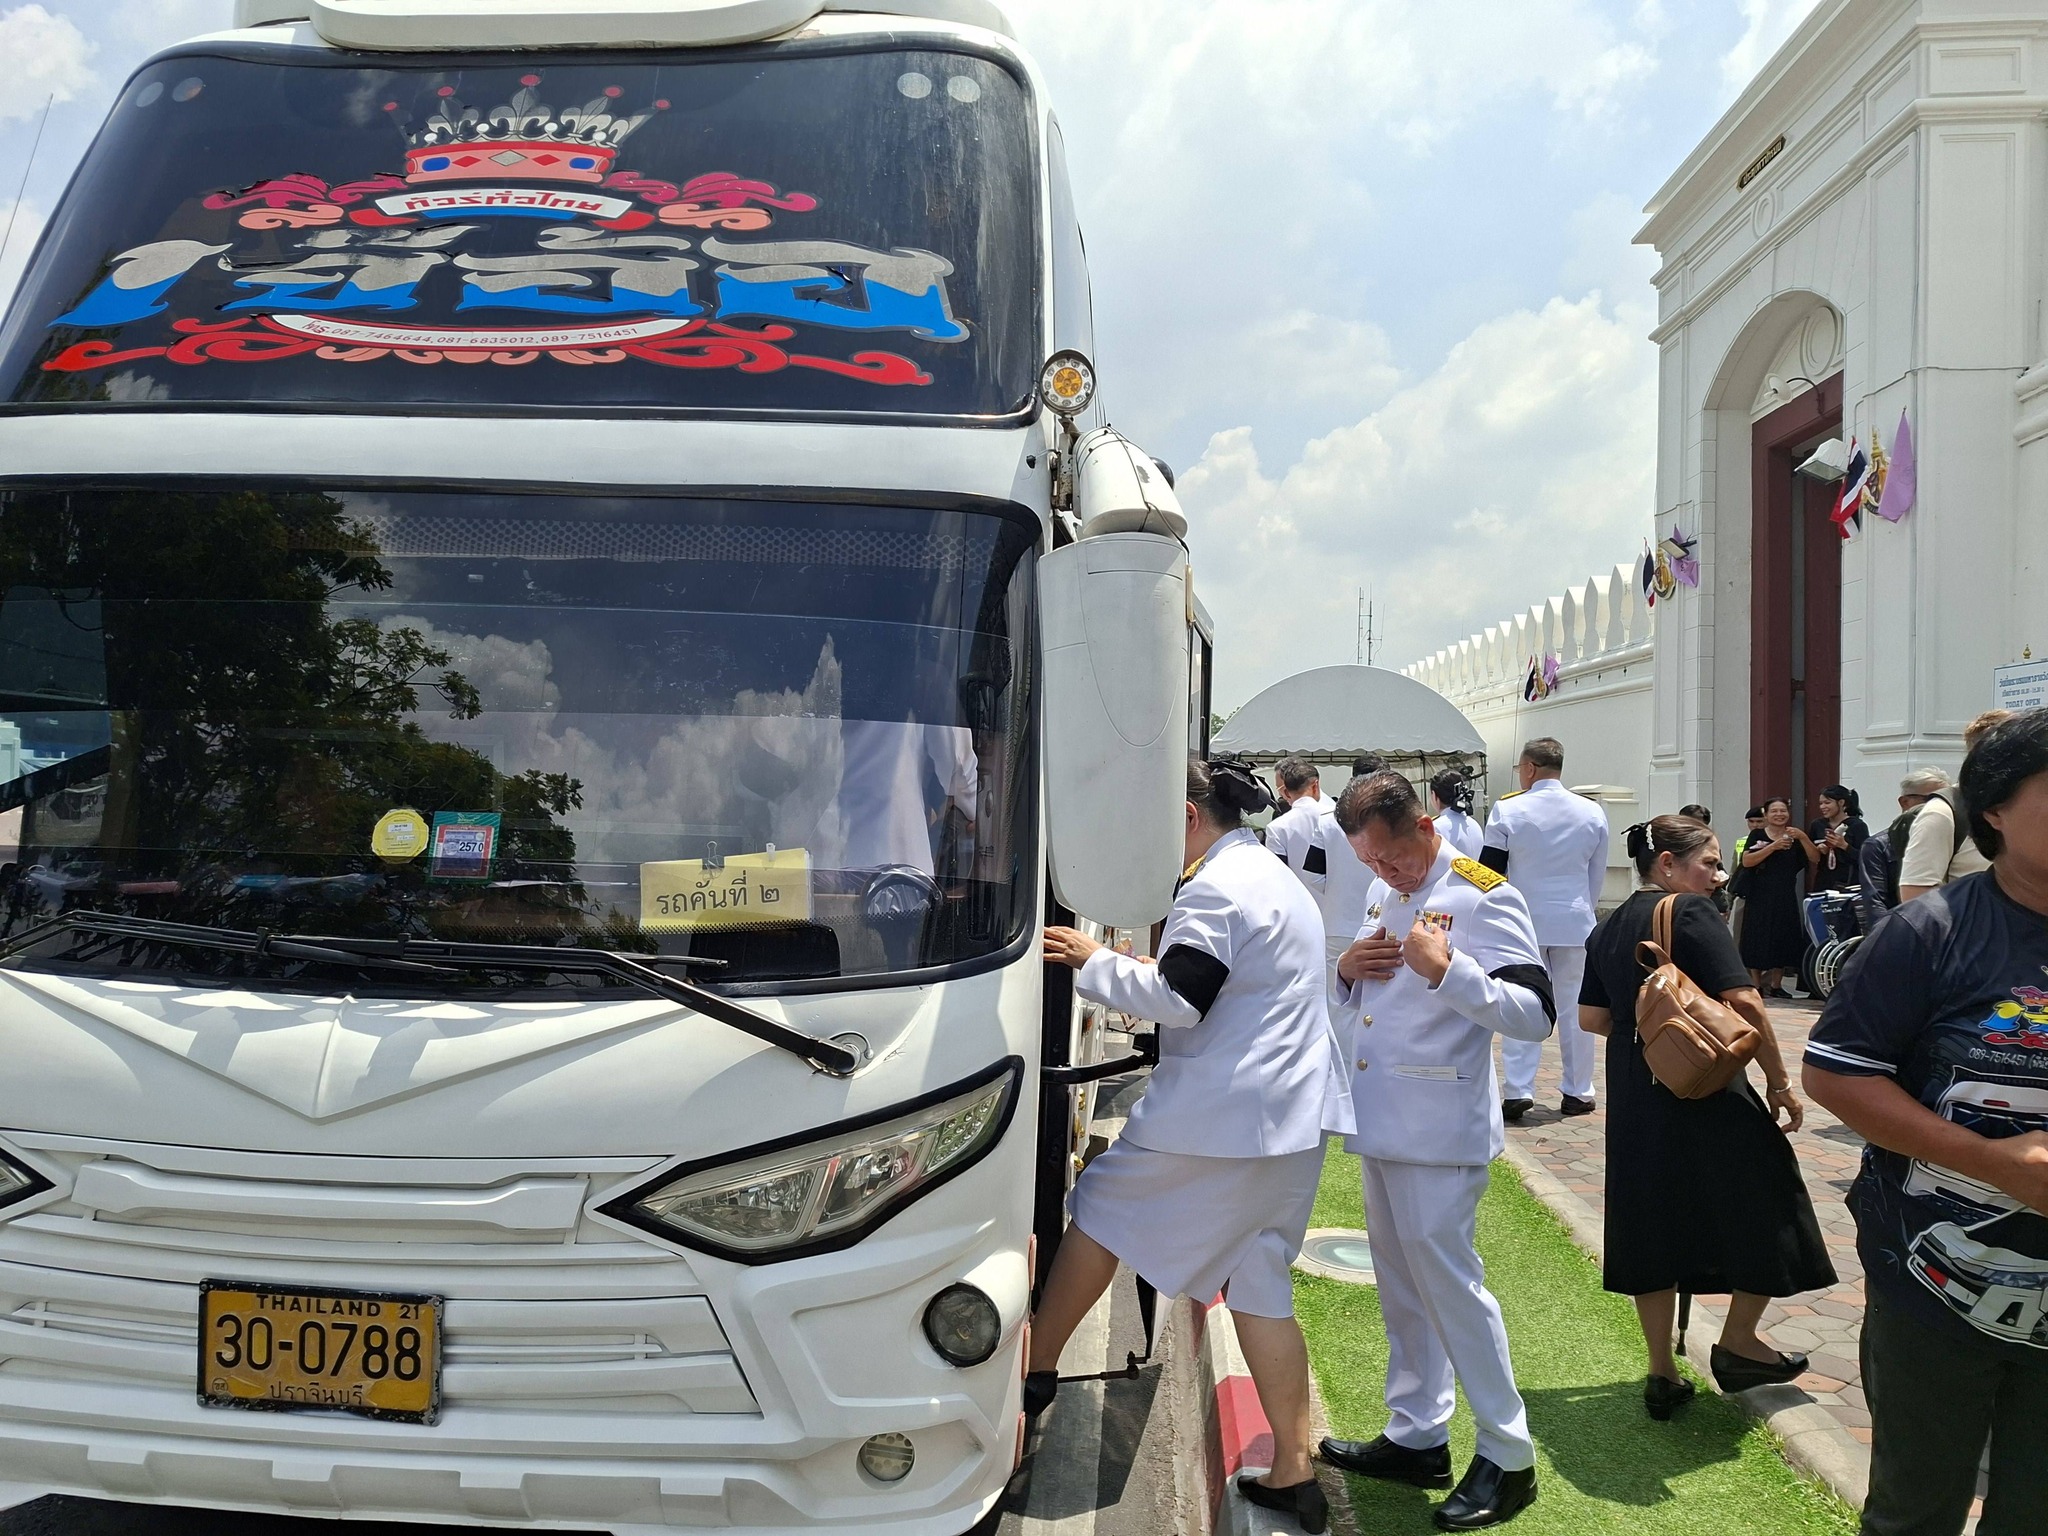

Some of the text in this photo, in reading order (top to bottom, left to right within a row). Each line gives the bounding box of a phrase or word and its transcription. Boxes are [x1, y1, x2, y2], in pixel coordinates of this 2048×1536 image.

[405, 190, 603, 212] ทัวร์ทั่วไทย
[2005, 698, 2041, 708] TODAY OPEN
[656, 870, 780, 915] รถคันที่ ๒
[1968, 1047, 2028, 1066] 089-7516451
[256, 1294, 420, 1320] THAILAND 21
[215, 1314, 421, 1381] 30-0788
[270, 1380, 363, 1406] ปราจีนบรี
